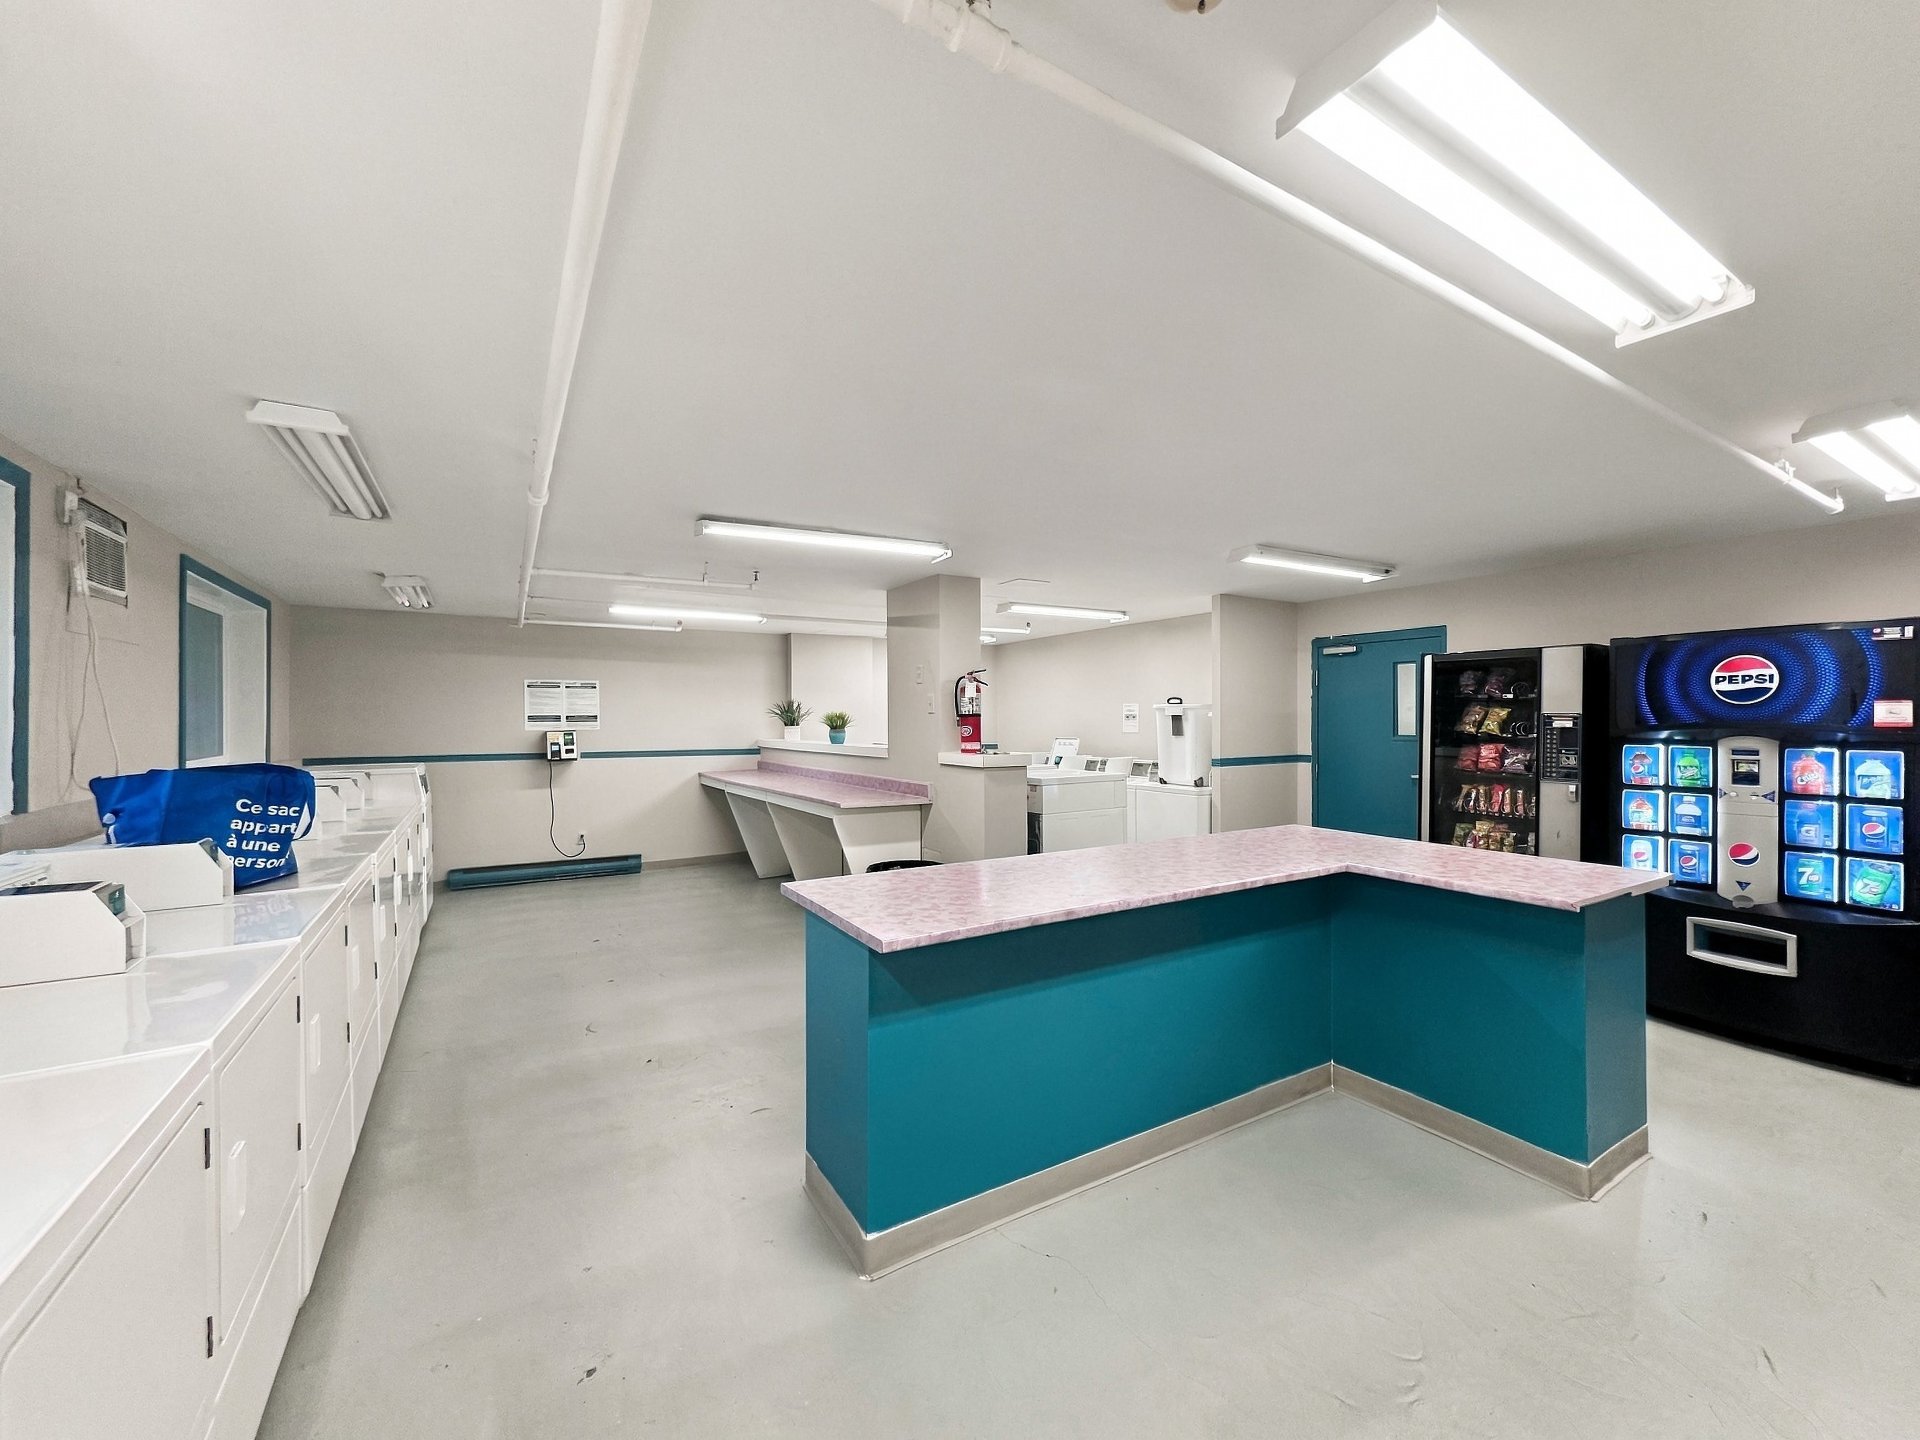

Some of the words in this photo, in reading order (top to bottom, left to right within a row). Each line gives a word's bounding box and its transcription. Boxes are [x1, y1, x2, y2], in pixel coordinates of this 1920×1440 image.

[1714, 673, 1775, 685] PEPSI
[235, 798, 263, 814] Ce
[267, 805, 300, 816] sac
[226, 833, 238, 848] à
[241, 840, 281, 852] une
